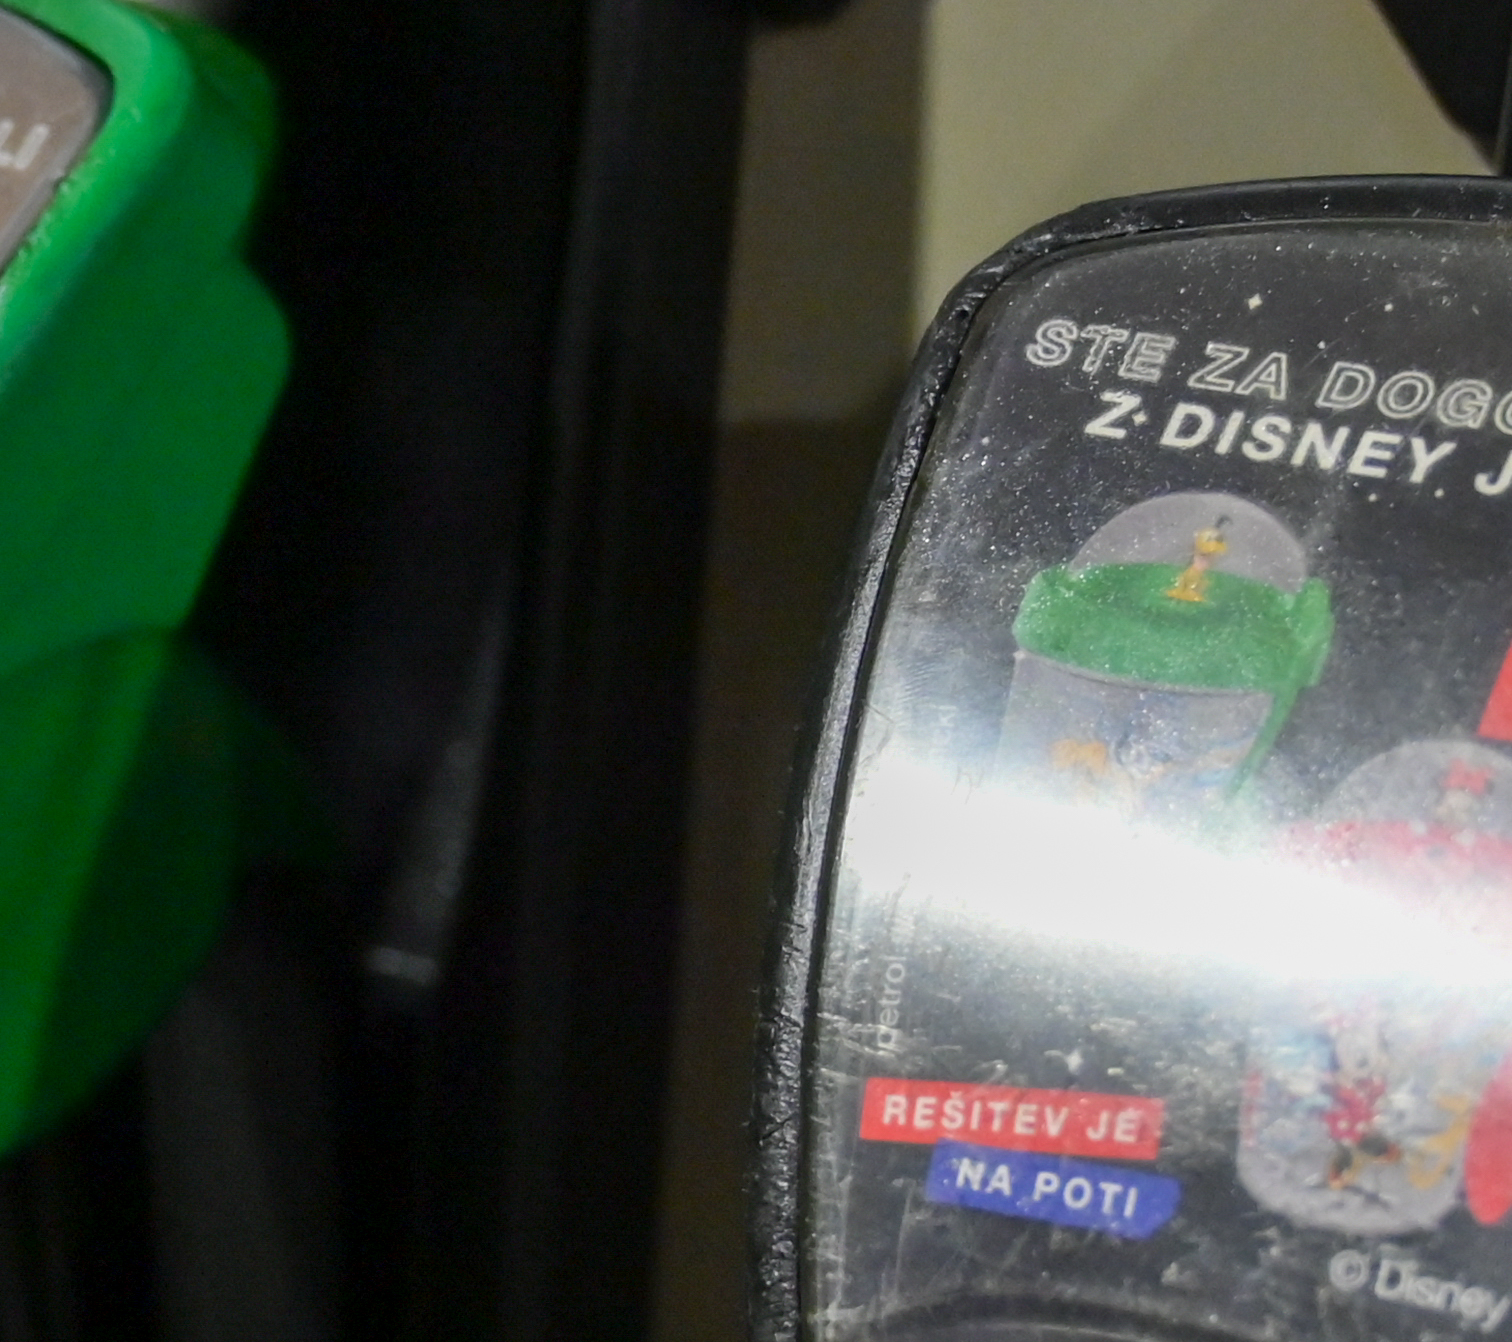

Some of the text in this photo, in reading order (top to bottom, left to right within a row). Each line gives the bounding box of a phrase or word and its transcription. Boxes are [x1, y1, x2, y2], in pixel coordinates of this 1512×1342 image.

[1026, 317, 1177, 384] STE
[1187, 341, 1290, 401] ZA
[1084, 389, 1142, 440] Z
[1159, 401, 1457, 484] DISNEY
[882, 1090, 1143, 1144] REŠITEV JE
[954, 1157, 1140, 1219] NA POTI
